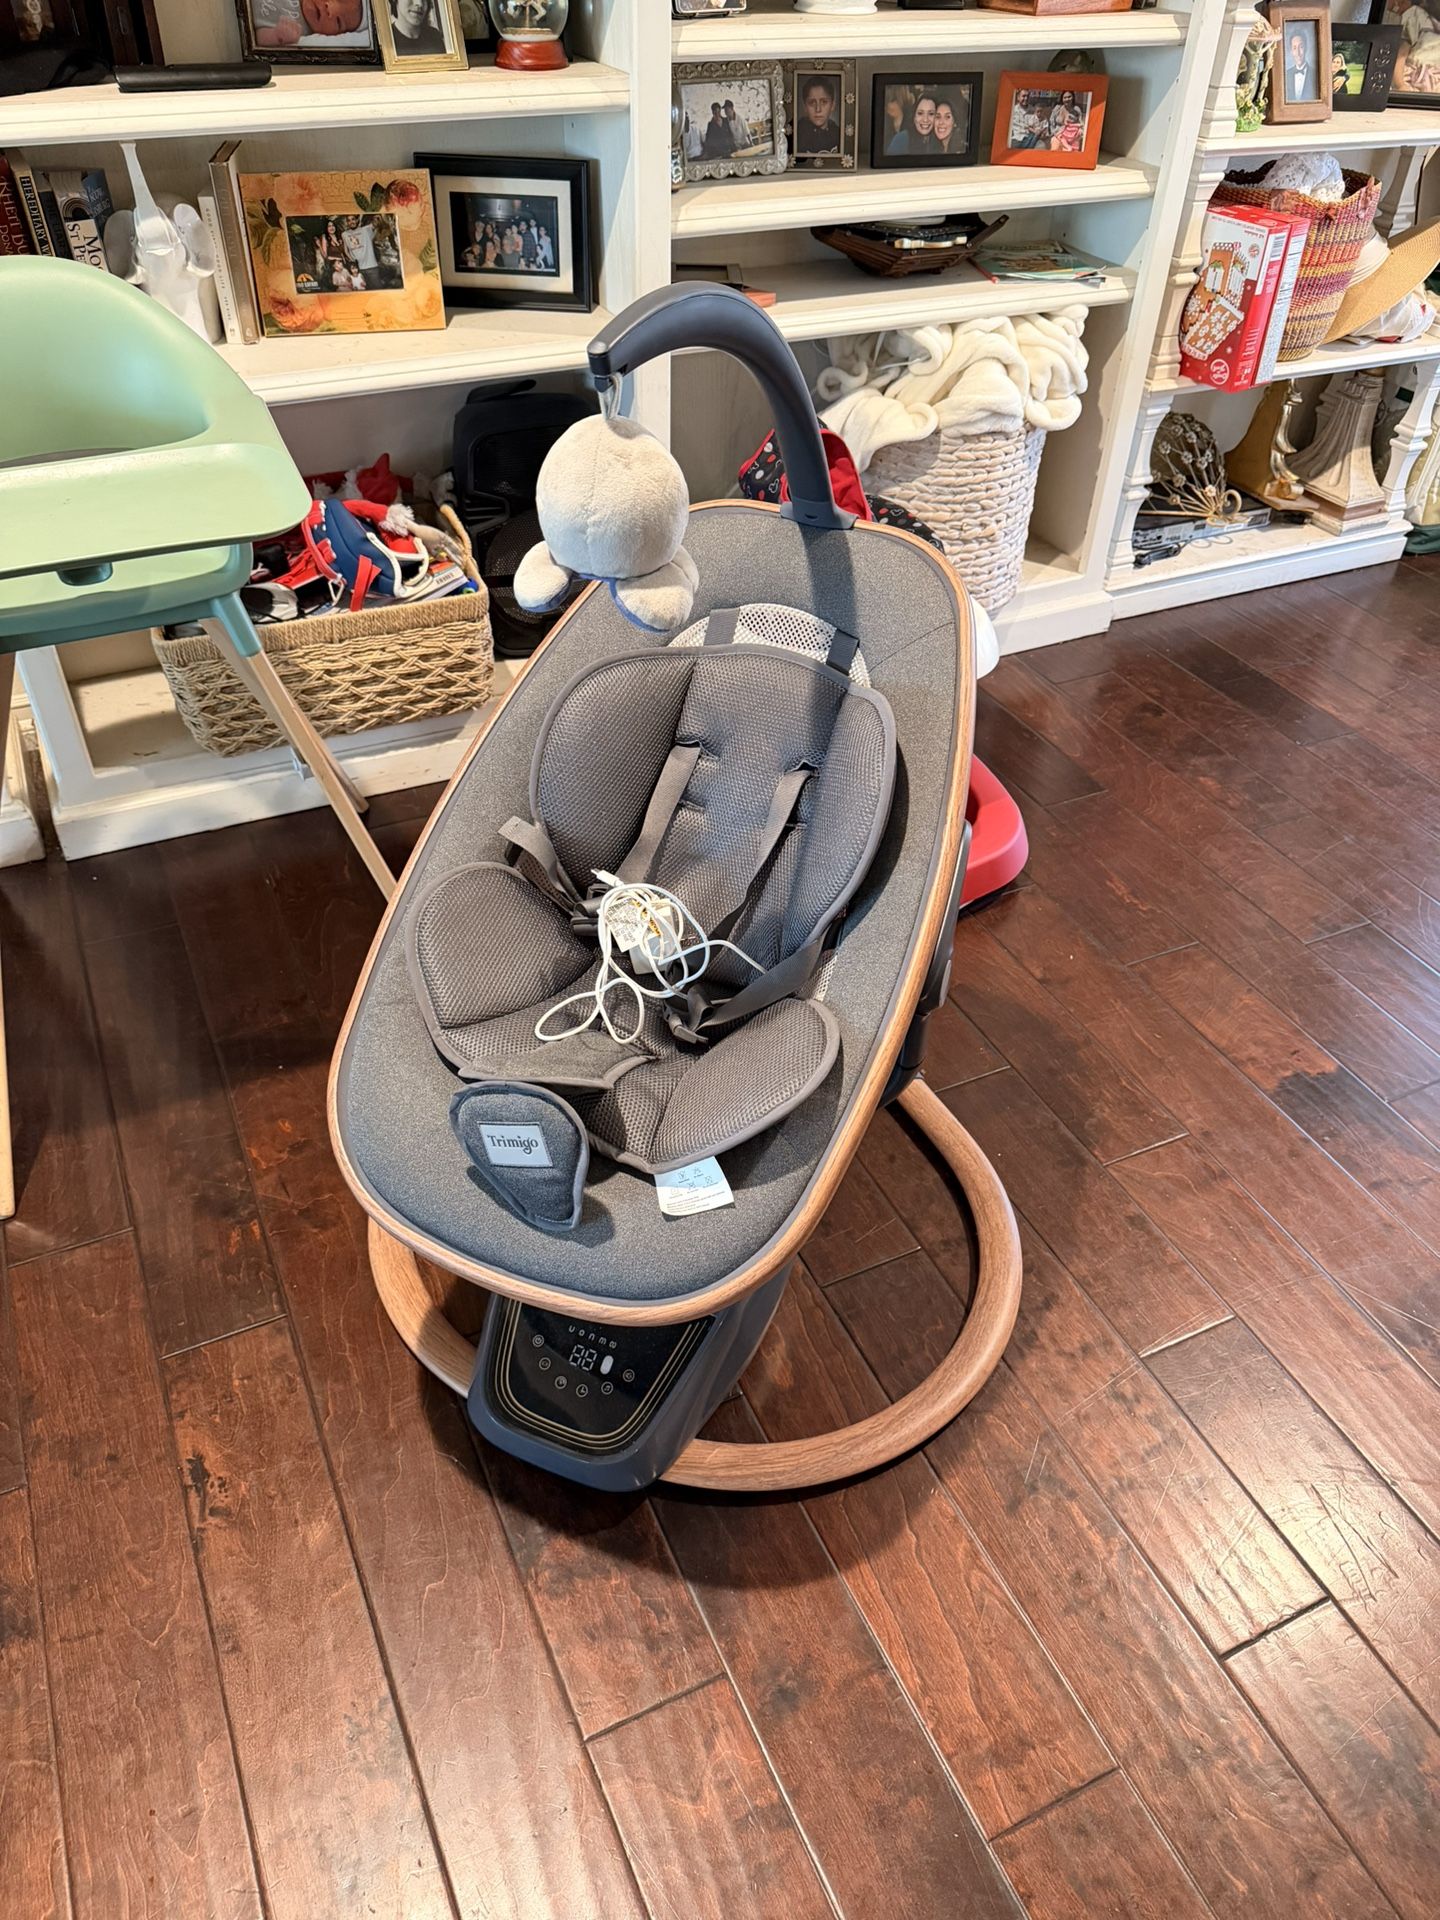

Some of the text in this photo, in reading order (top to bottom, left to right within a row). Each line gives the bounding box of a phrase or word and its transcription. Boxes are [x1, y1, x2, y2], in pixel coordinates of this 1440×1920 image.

[21, 177, 45, 240] HEREDITARY
[83, 235, 104, 270] MO
[487, 1135, 538, 1154] Trimigo
